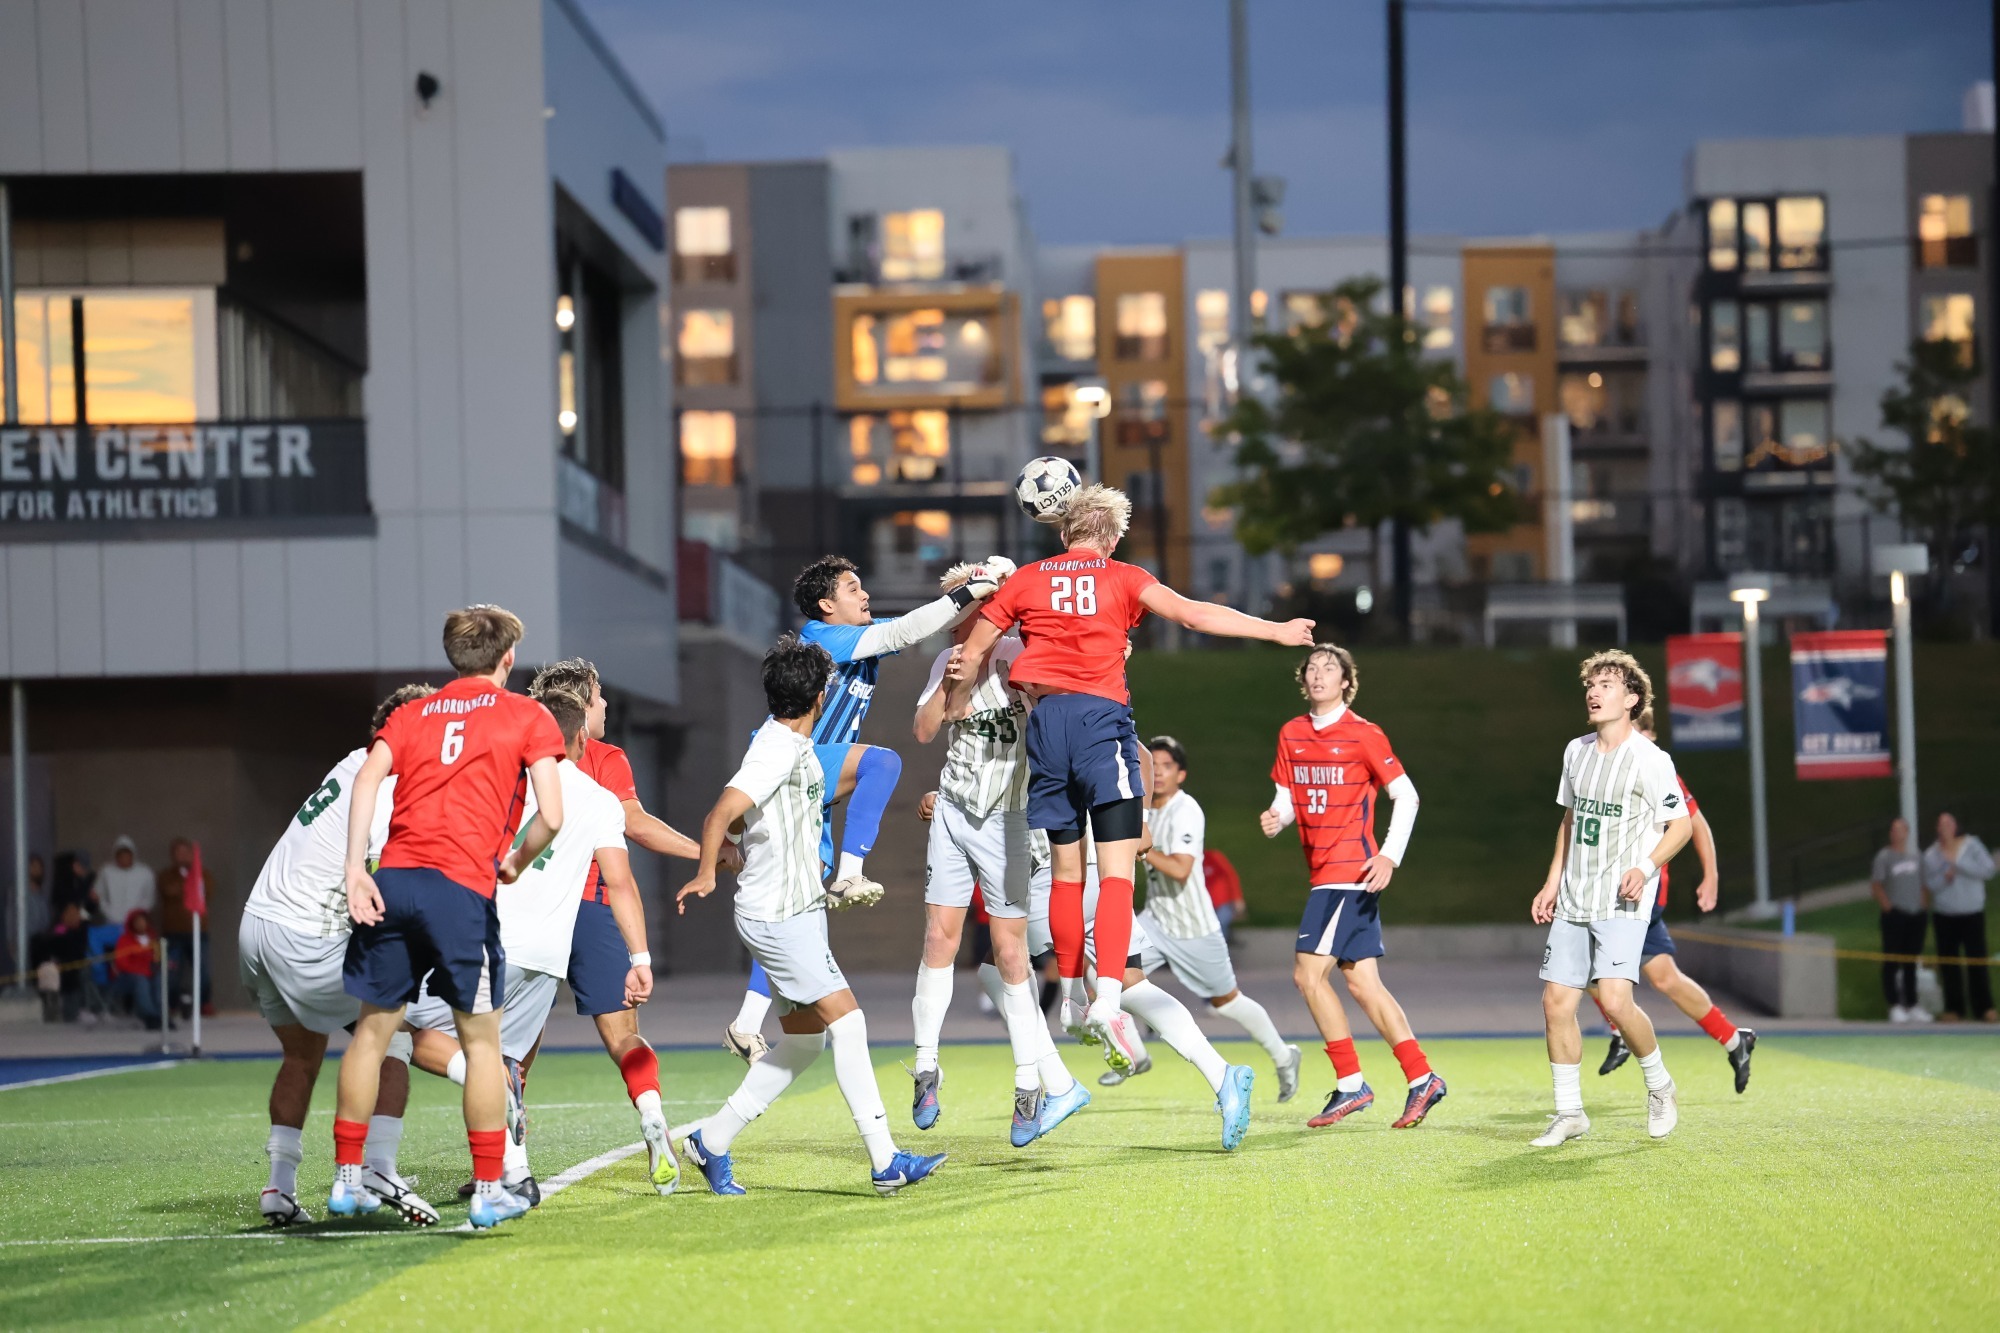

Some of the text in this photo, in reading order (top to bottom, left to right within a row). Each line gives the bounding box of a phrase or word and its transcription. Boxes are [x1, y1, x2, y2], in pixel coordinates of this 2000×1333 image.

[0, 424, 315, 481] EN CENTER
[0, 487, 218, 520] FOR ATHLETICS
[1039, 481, 1072, 510] SELECT
[1039, 558, 1106, 572] ROADRUNNERS
[1051, 575, 1097, 616] 28
[421, 693, 497, 717] ROADRUNNERS
[440, 720, 466, 766] 6
[977, 718, 1017, 744] 43
[1293, 766, 1345, 785] MSU DENVER
[1307, 788, 1328, 815] 33
[1576, 815, 1601, 847] 19
